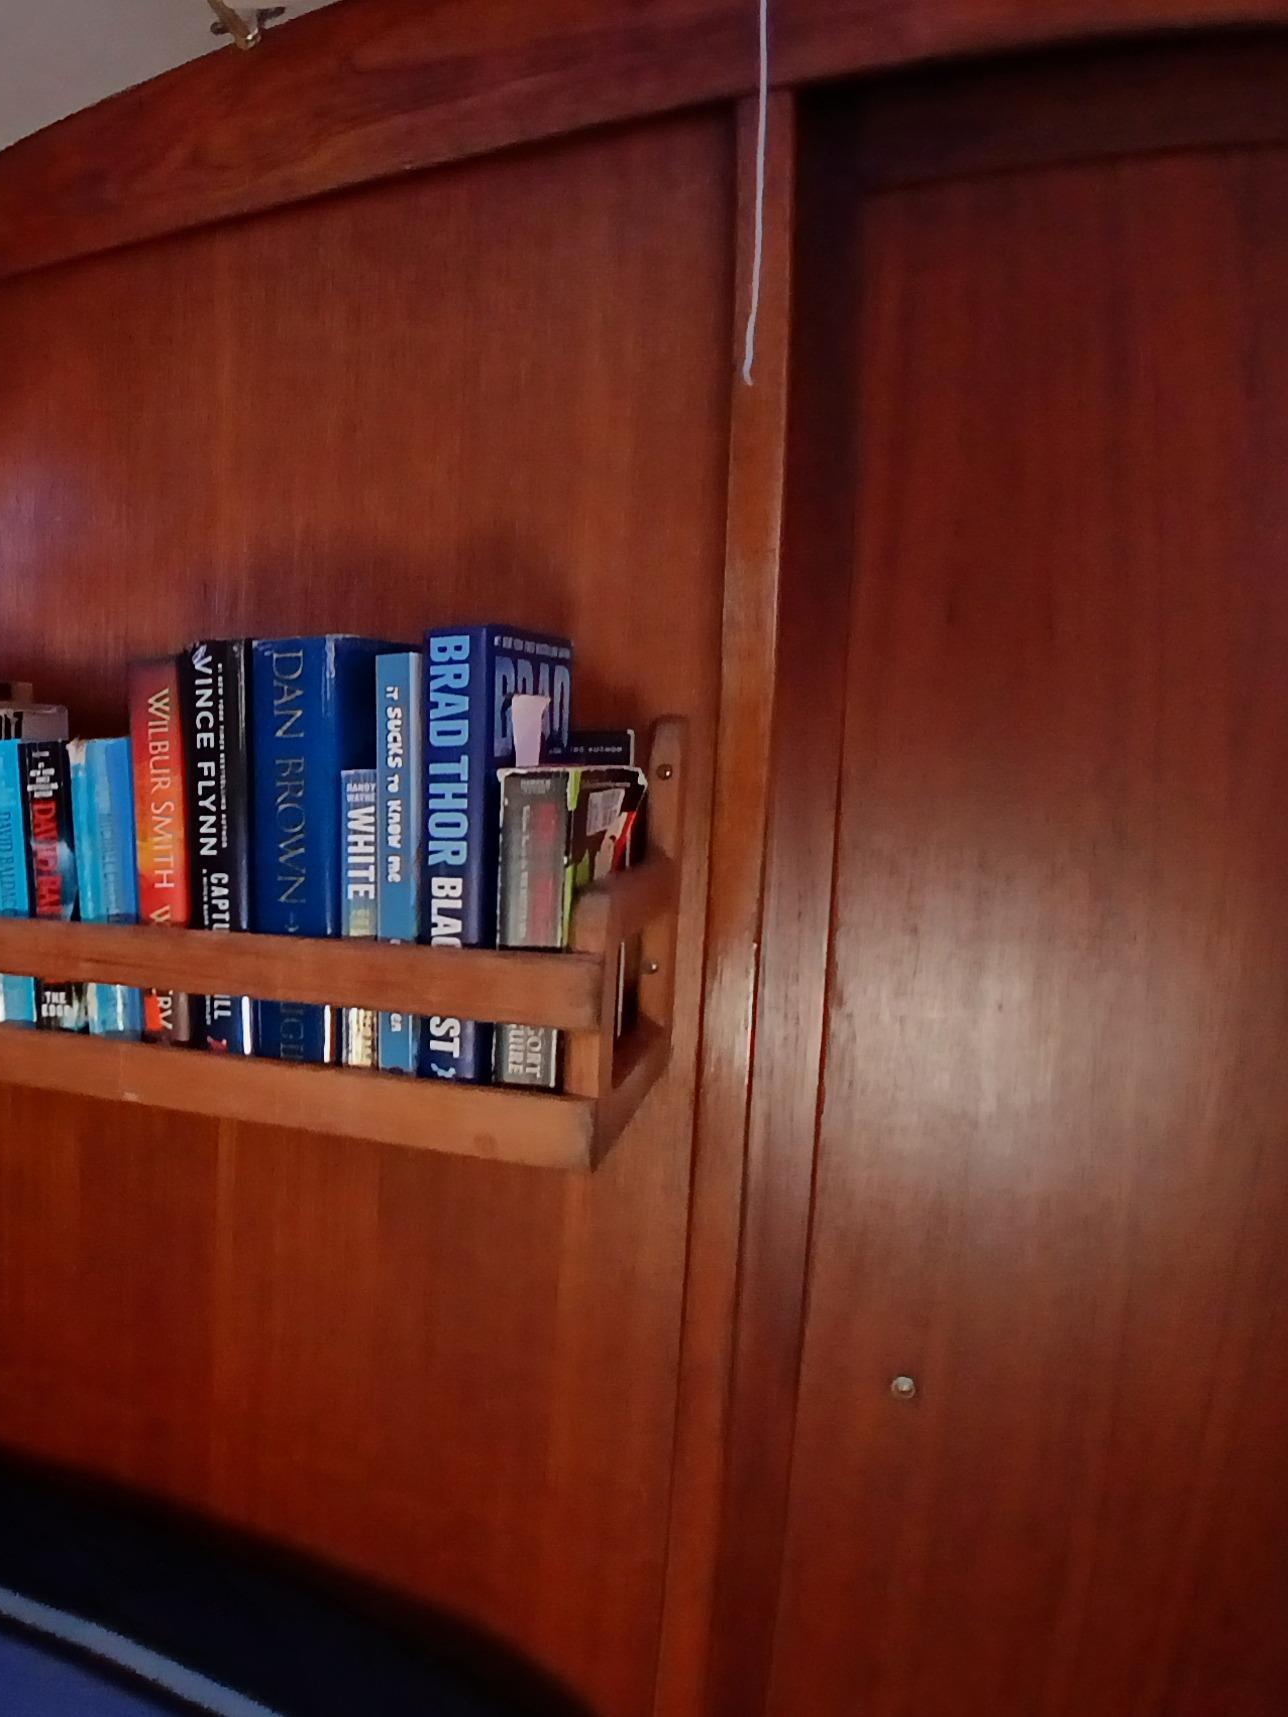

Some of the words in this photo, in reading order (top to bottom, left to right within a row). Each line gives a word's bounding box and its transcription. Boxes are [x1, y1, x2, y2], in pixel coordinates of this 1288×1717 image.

[194, 655, 215, 750] VINCE
[272, 648, 304, 739] DAN
[386, 706, 403, 769] SUCKS
[429, 634, 471, 747] BRAD
[147, 687, 172, 793] WILBUR
[31, 801, 59, 872] DAVID
[151, 800, 175, 889] SMITH
[197, 760, 218, 856] FLYNN
[275, 756, 306, 904] BROWN
[347, 805, 375, 900] WHITE
[428, 760, 470, 867] THOR
